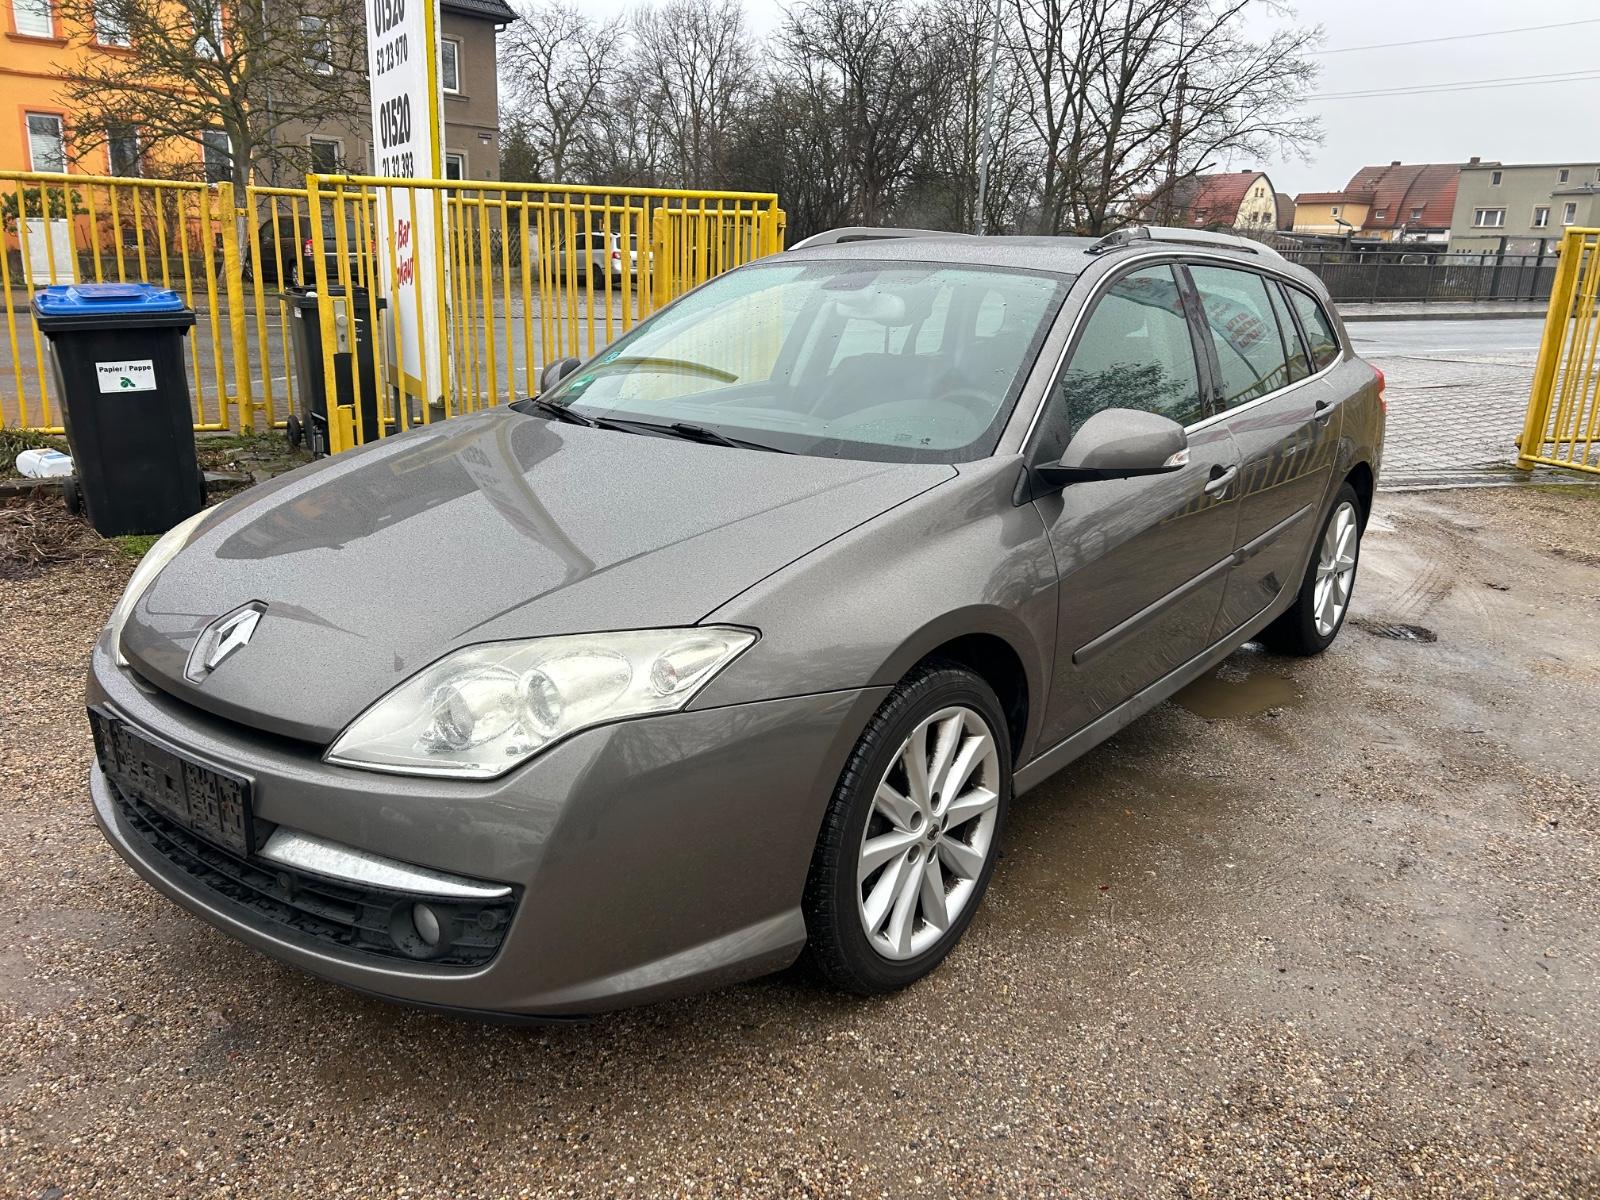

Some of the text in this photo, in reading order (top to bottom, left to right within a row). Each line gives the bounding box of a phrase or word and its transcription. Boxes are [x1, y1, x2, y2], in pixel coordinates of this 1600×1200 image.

[376, 32, 408, 76] 52 23 970
[380, 92, 411, 150] 01520
[401, 151, 414, 178] 393
[397, 218, 410, 251] Bar
